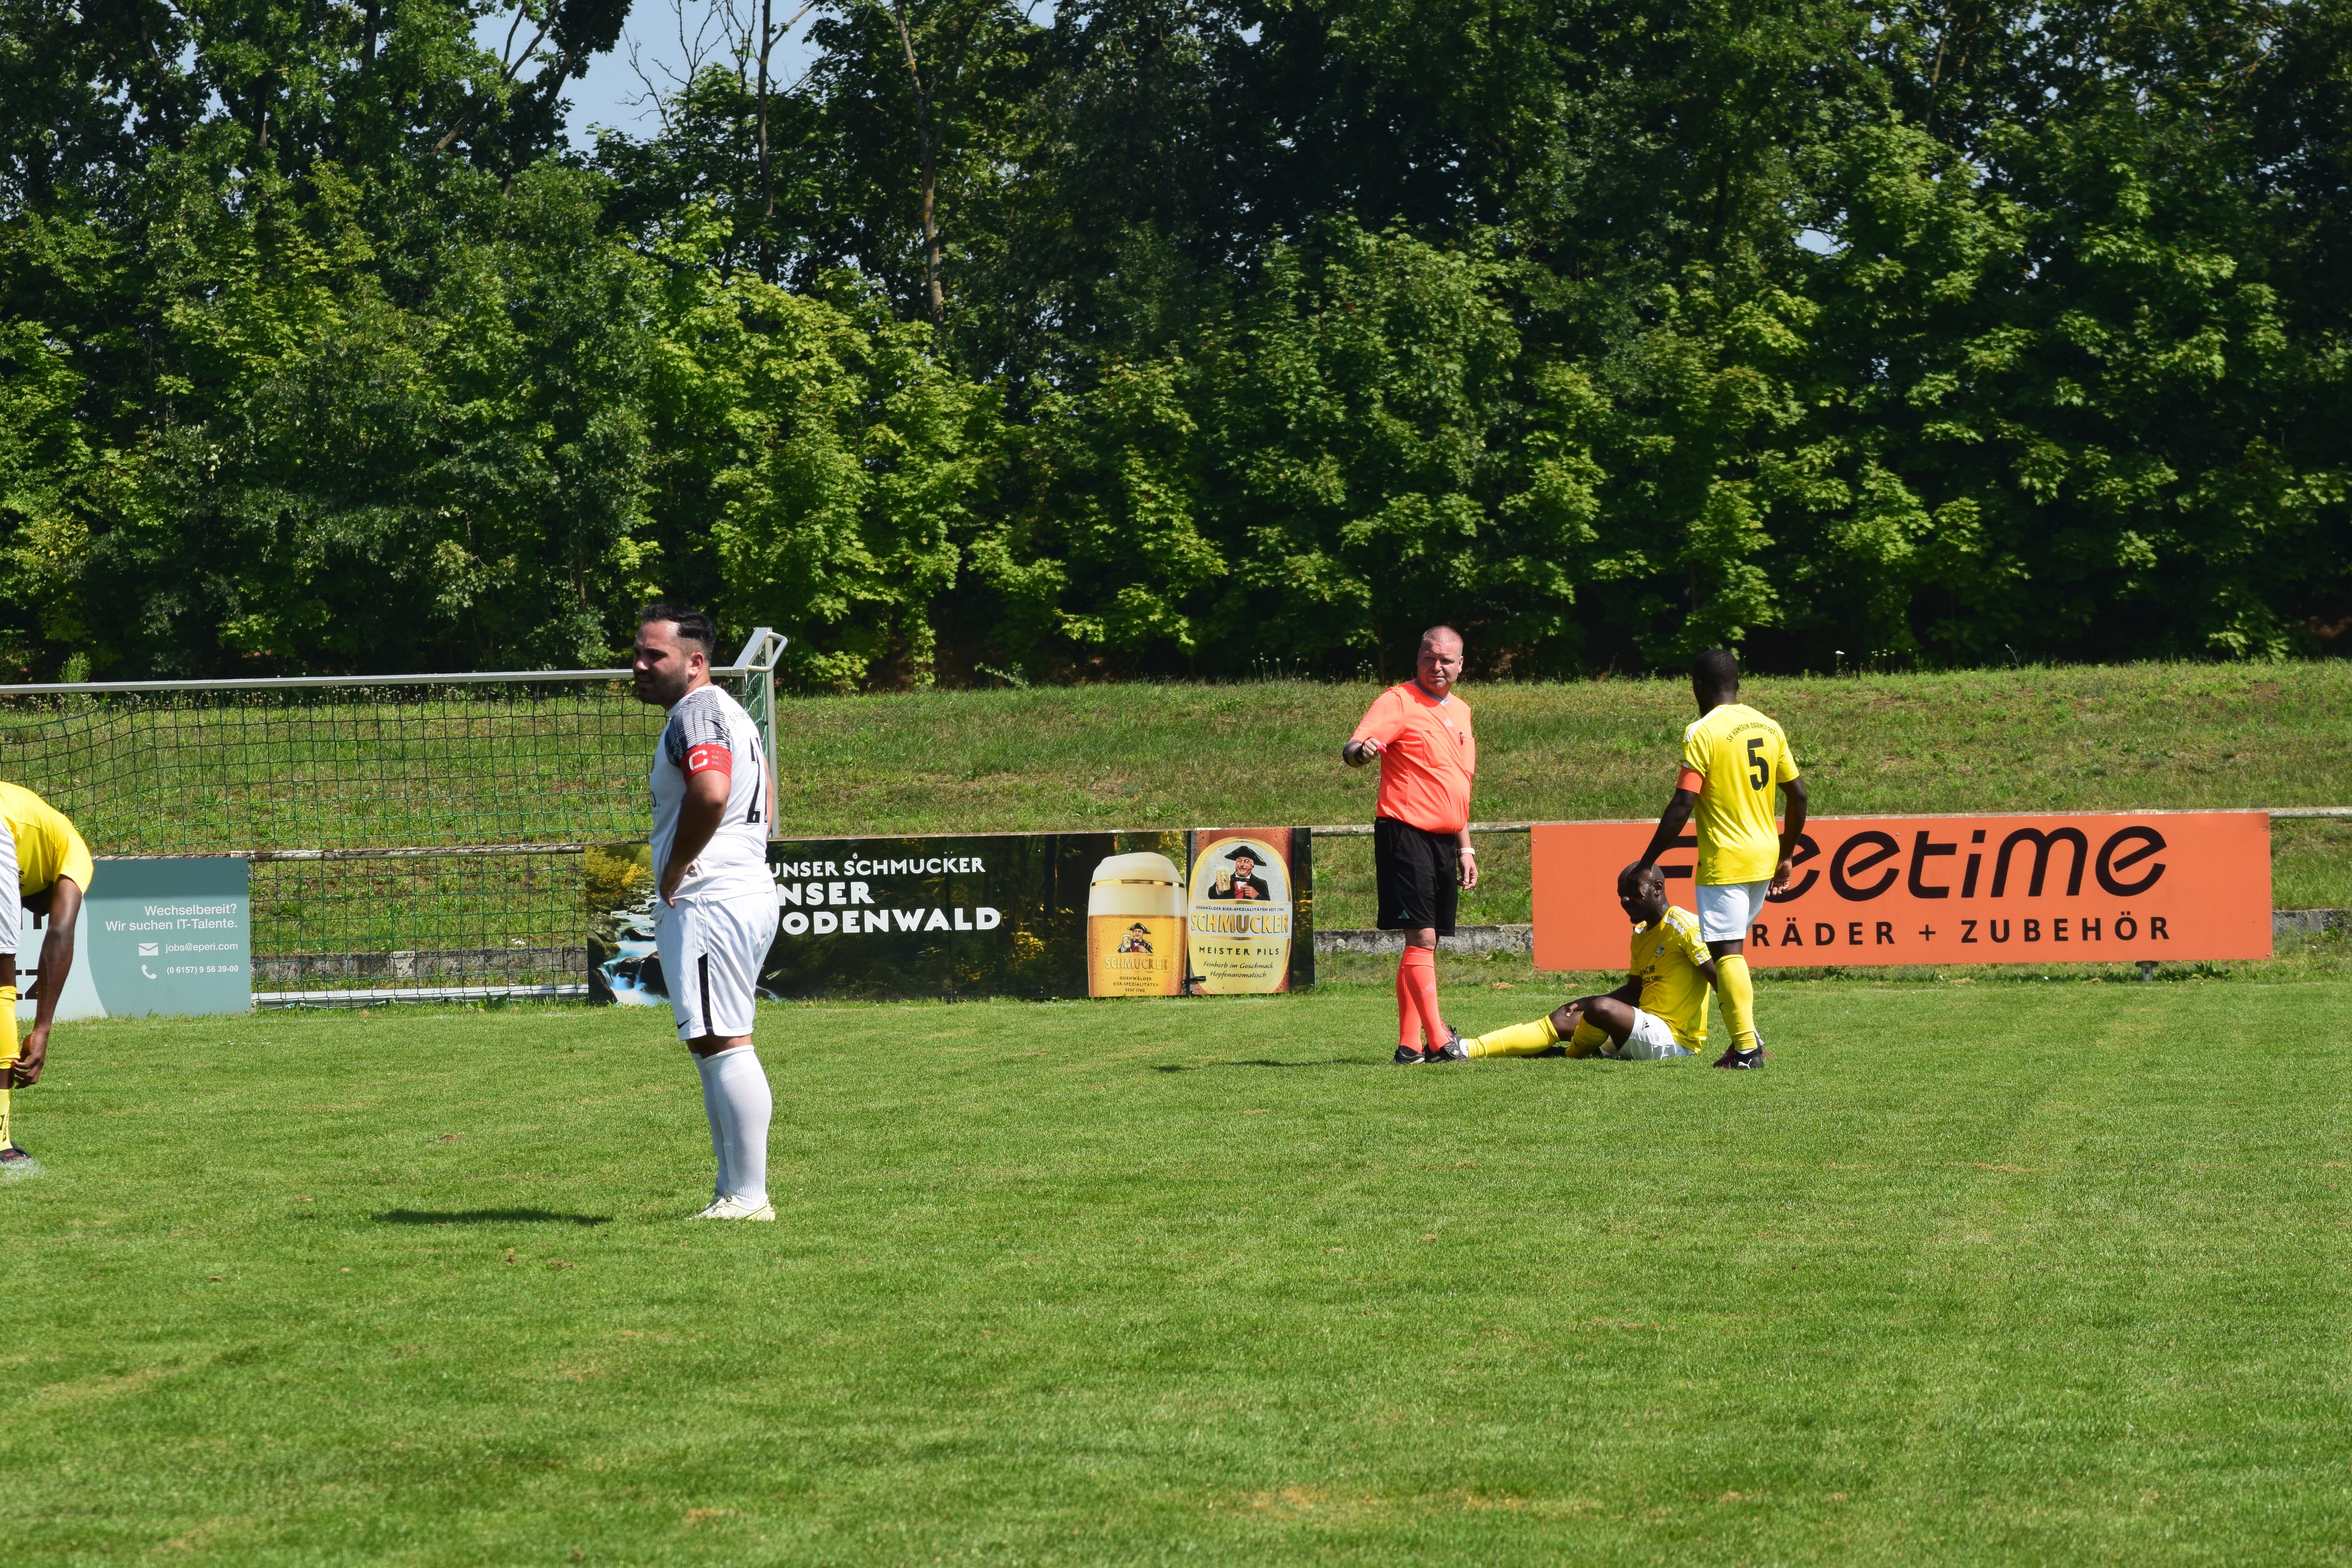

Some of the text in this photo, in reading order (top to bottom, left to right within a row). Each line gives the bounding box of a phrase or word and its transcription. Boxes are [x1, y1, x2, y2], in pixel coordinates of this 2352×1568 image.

[1726, 733, 1734, 742] SV
[1750, 722, 1775, 736] DARMSTADT
[689, 750, 708, 771] C
[1747, 737, 1769, 792] 5
[766, 857, 986, 878] UNSER SCHMUCKER
[777, 881, 875, 906] NSER
[144, 903, 237, 916] Wechselbereit?
[105, 918, 238, 931] Wir suchen IT-Talente.
[782, 907, 1001, 935] ODENWALD
[1191, 911, 1289, 934] SCHMUCKER
[1752, 917, 1895, 947] RÄDER
[1961, 911, 2169, 943] ZUBEHÖR
[165, 943, 238, 953] jobs@eperi.com
[1199, 946, 1250, 955] MEISTER
[167, 967, 174, 975] (0
[176, 966, 197, 975] 6157)
[1105, 957, 1167, 970] SCHMUCKER
[1210, 971, 1267, 979] Hopfenaromatisch
